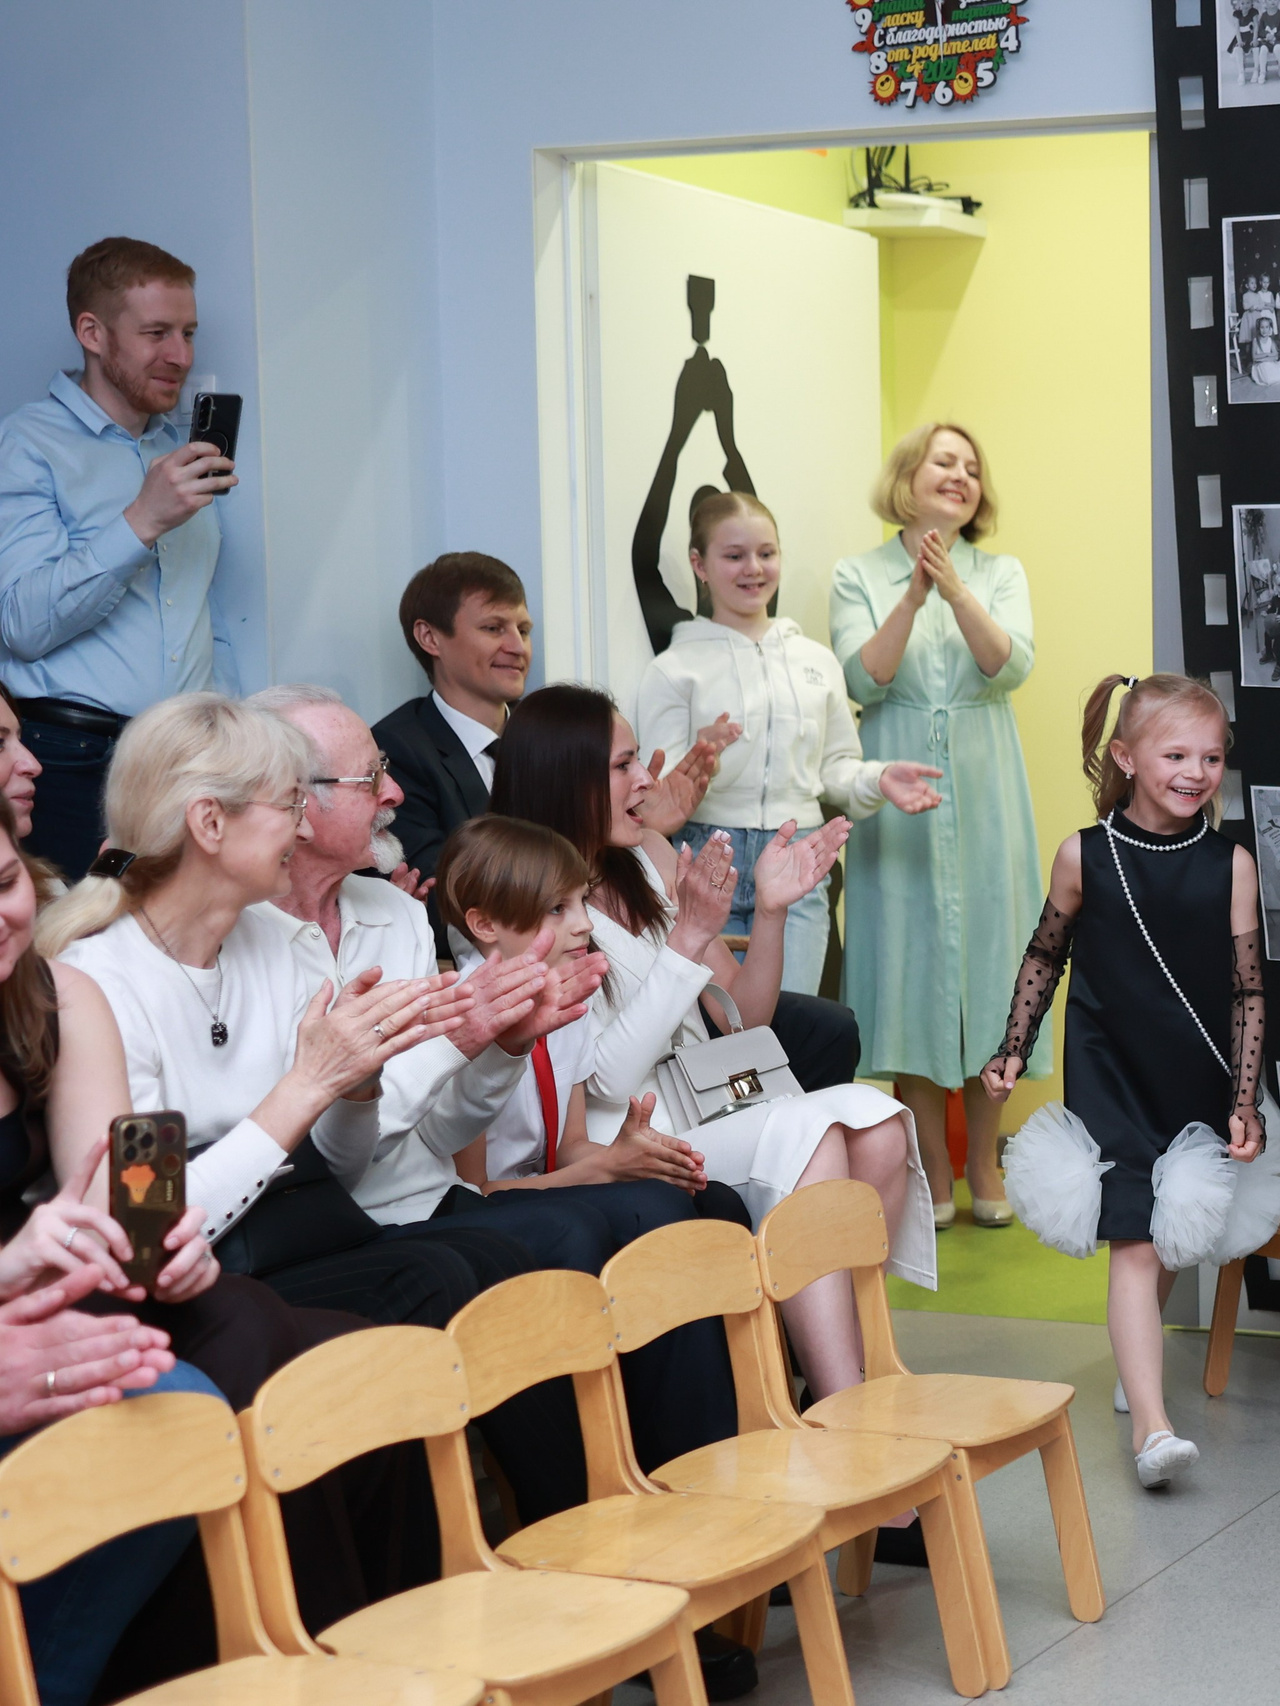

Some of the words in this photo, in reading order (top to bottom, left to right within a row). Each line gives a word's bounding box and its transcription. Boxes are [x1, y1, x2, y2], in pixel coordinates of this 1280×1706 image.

[855, 8, 873, 33] 9
[881, 10, 926, 28] ласку
[951, 3, 1011, 22] терпение
[873, 28, 885, 48] С
[1000, 25, 1019, 52] 4
[869, 51, 888, 75] 8
[887, 47, 911, 63] от
[922, 57, 959, 84] 2021
[976, 61, 995, 88] 5
[900, 81, 918, 107] 7
[934, 80, 953, 105] 6
